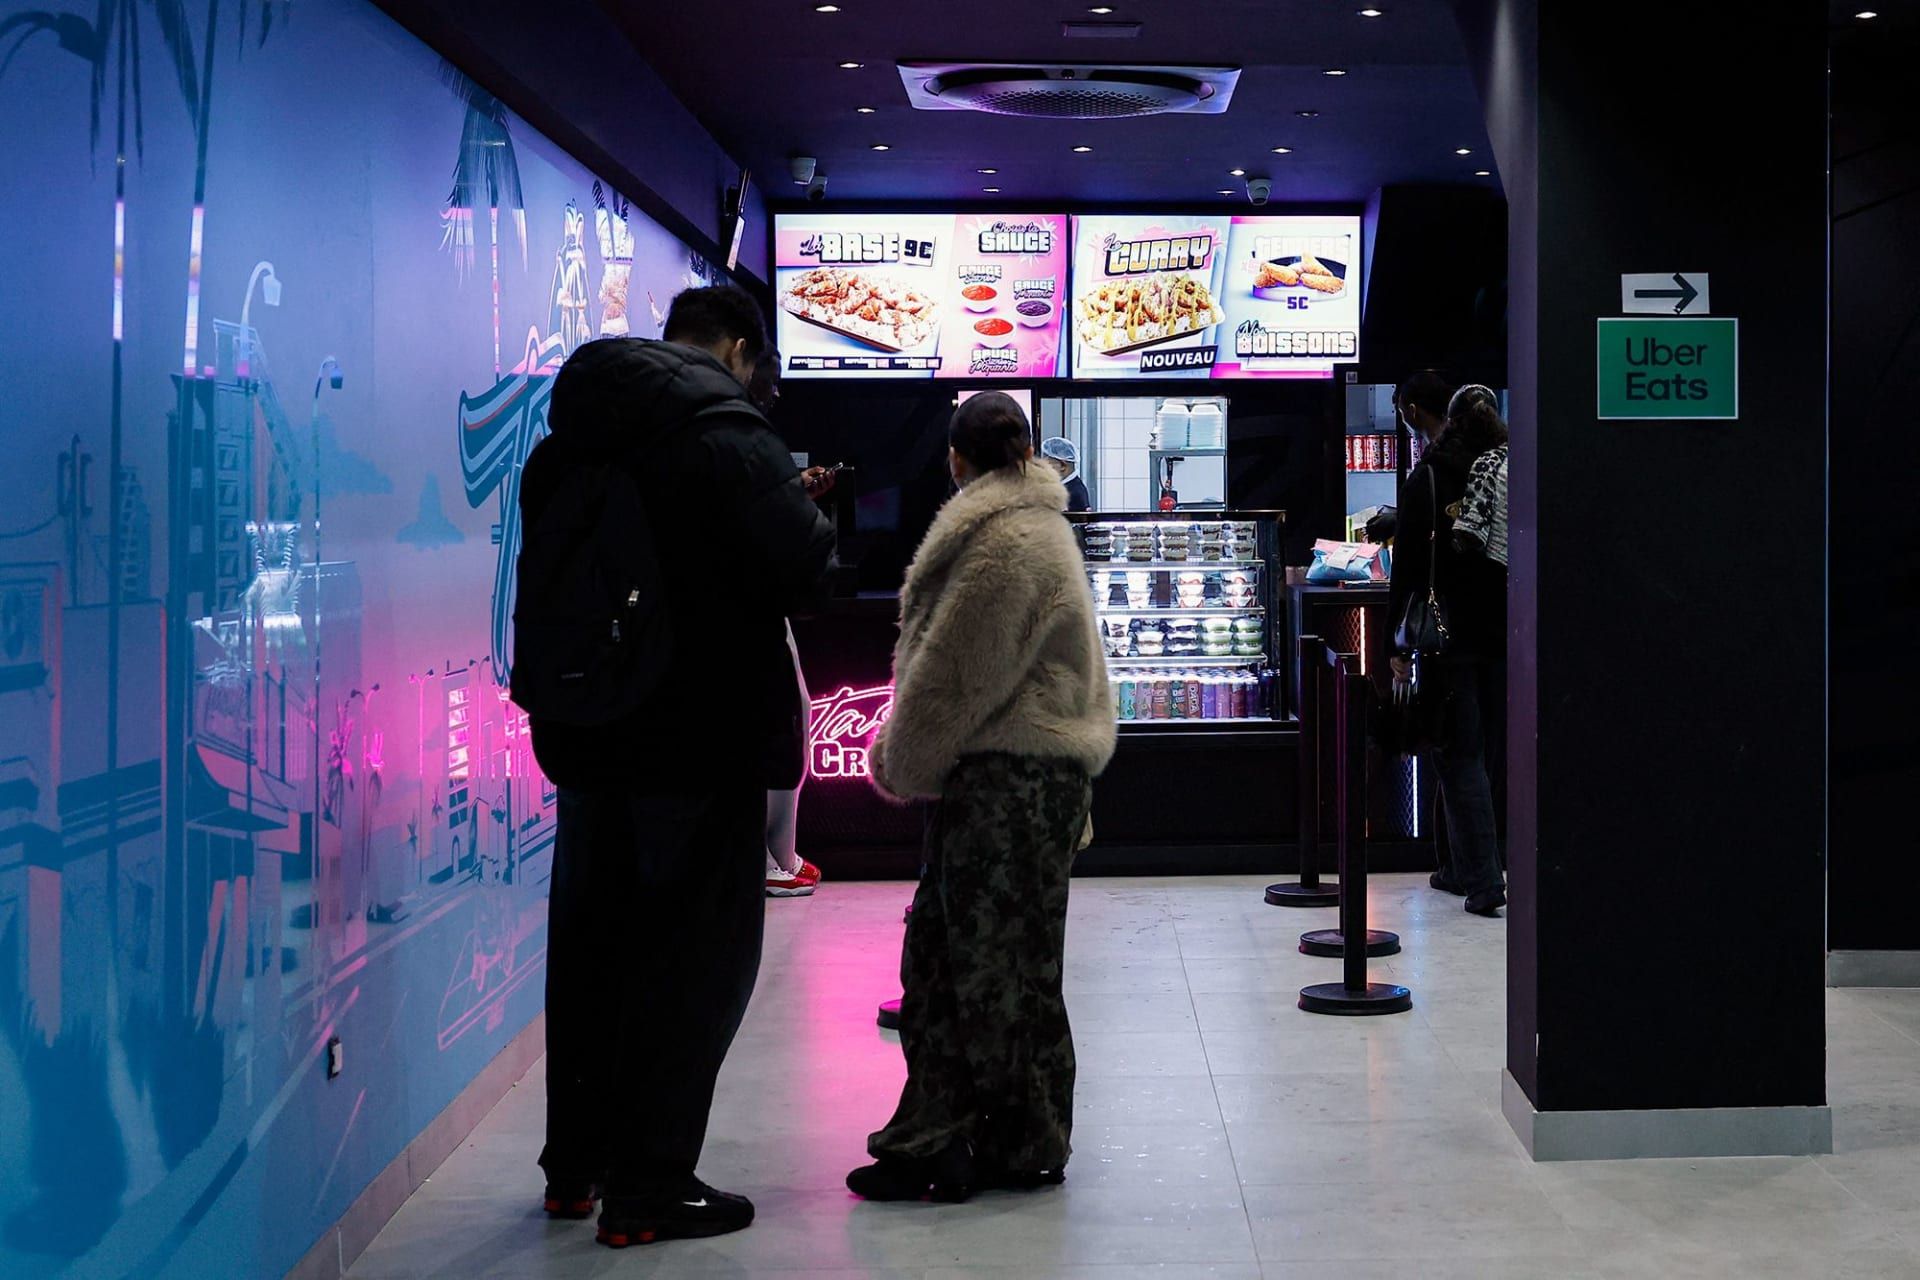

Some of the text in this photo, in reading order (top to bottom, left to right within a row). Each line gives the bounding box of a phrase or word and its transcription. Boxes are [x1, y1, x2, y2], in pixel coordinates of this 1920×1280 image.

[820, 232, 900, 263] BASE
[979, 231, 1051, 253] SAUCE
[1105, 235, 1212, 276] CURRY
[1013, 280, 1055, 293] SAUCE
[971, 348, 1018, 363] SAUCE
[1235, 331, 1357, 358] BOISSONS
[1625, 337, 1708, 366] Uber
[1142, 352, 1215, 367] NOUVEAU
[1625, 372, 1709, 401] Eats
[810, 740, 868, 777] CR
